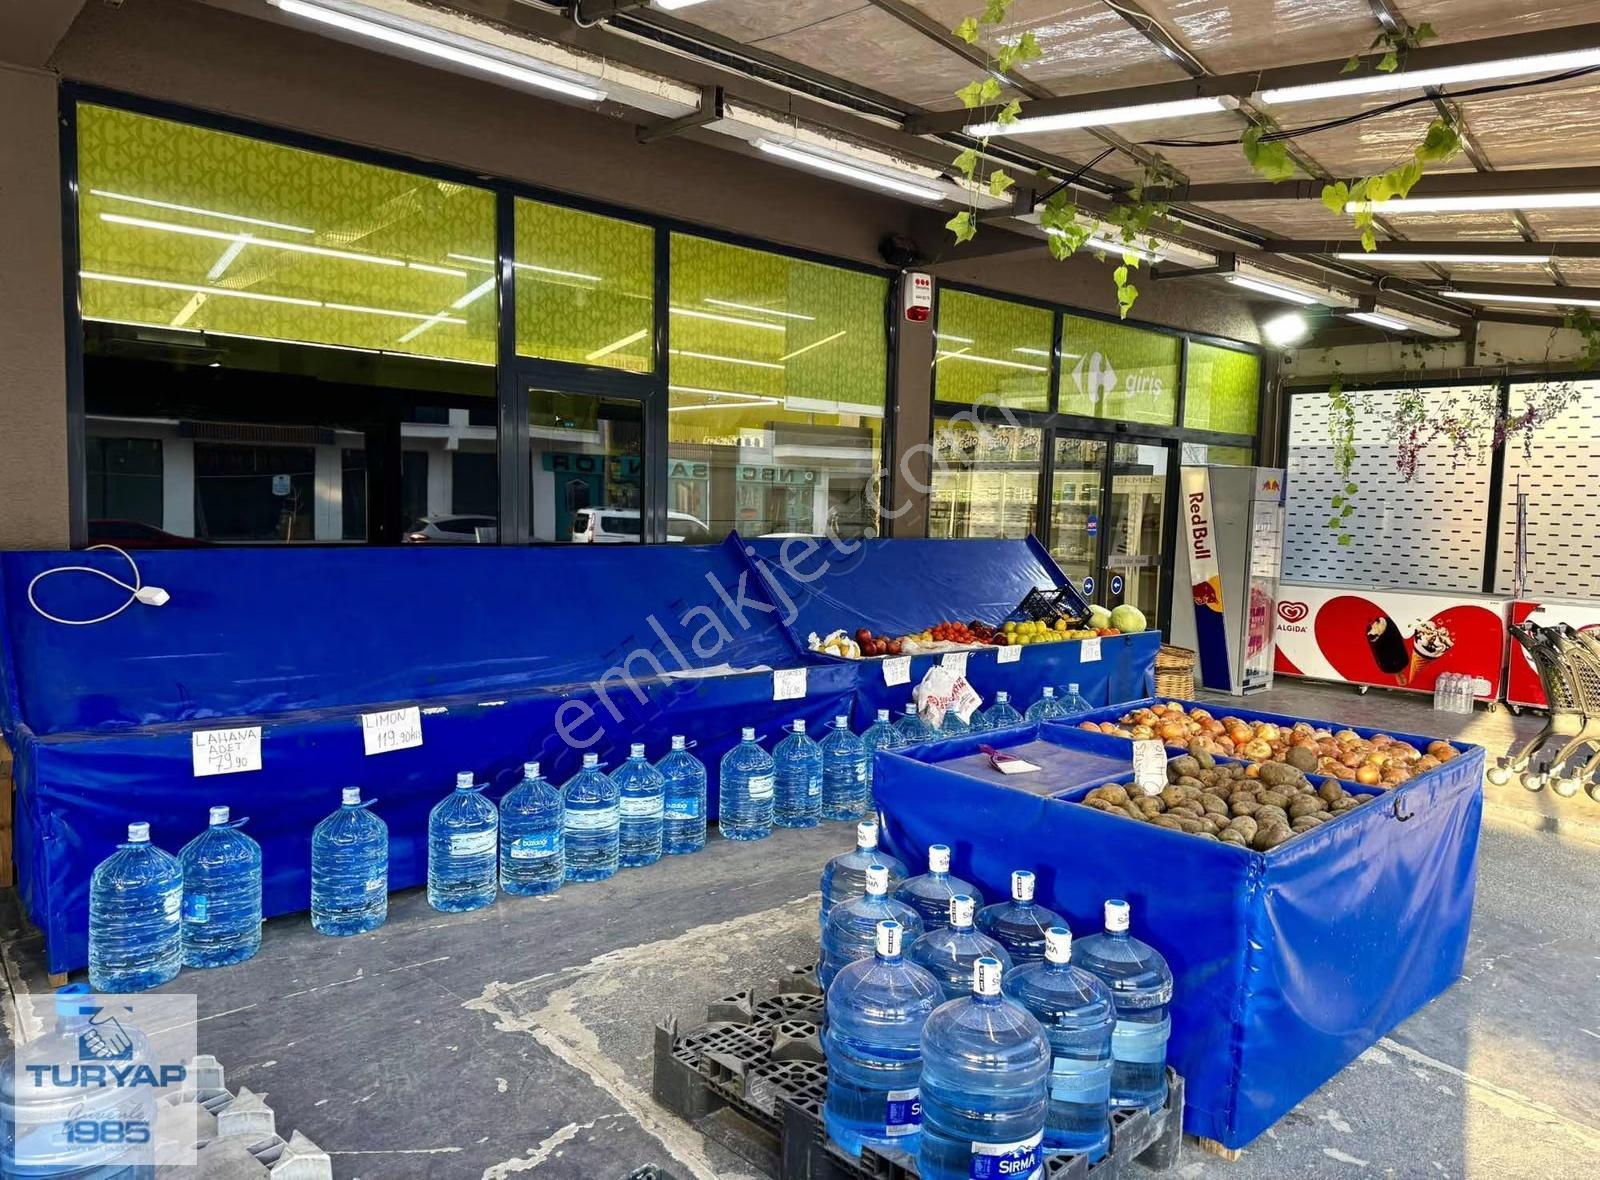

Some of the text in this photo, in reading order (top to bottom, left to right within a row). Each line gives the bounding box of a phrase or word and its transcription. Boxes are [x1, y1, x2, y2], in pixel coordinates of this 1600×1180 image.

[1125, 368, 1162, 402] giriş
[1189, 492, 1211, 559] Red Bull
[196, 729, 257, 747] LAHANA
[209, 742, 241, 755] ADET
[998, 1153, 1036, 1174] SIRMA
